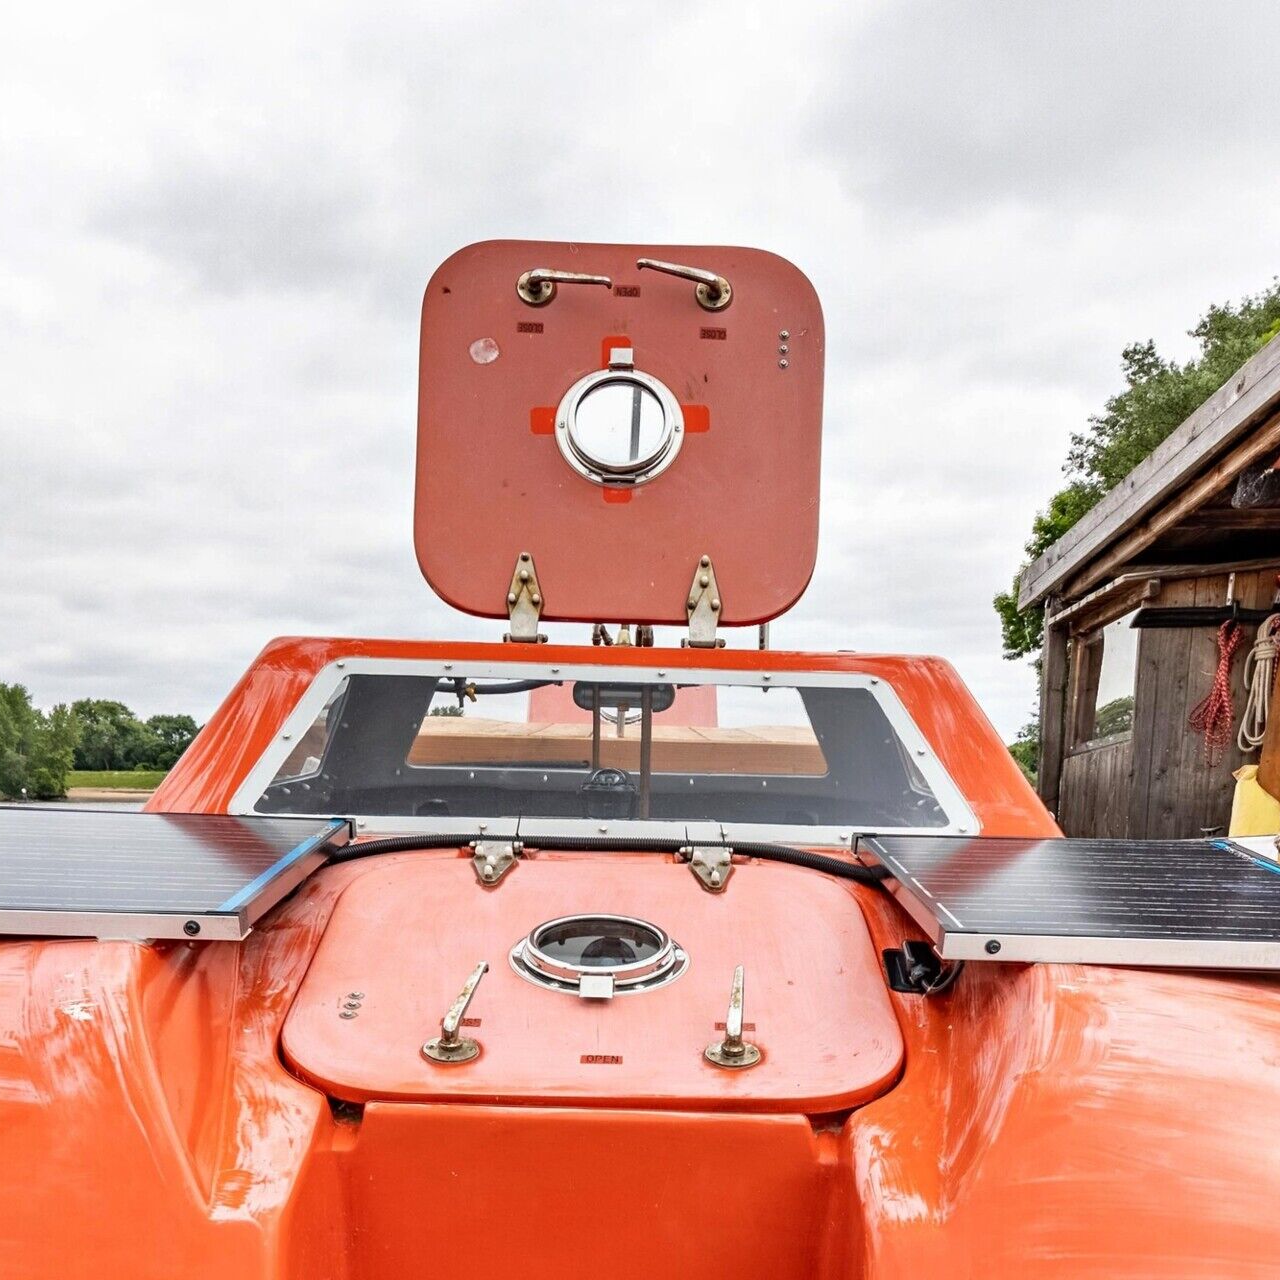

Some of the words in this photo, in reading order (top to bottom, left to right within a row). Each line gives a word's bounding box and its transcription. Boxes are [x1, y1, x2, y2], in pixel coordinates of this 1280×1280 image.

[616, 286, 639, 297] OPEN
[517, 322, 544, 334] CLOSE
[700, 328, 726, 340] CLOSE
[586, 1055, 619, 1064] OPEN
